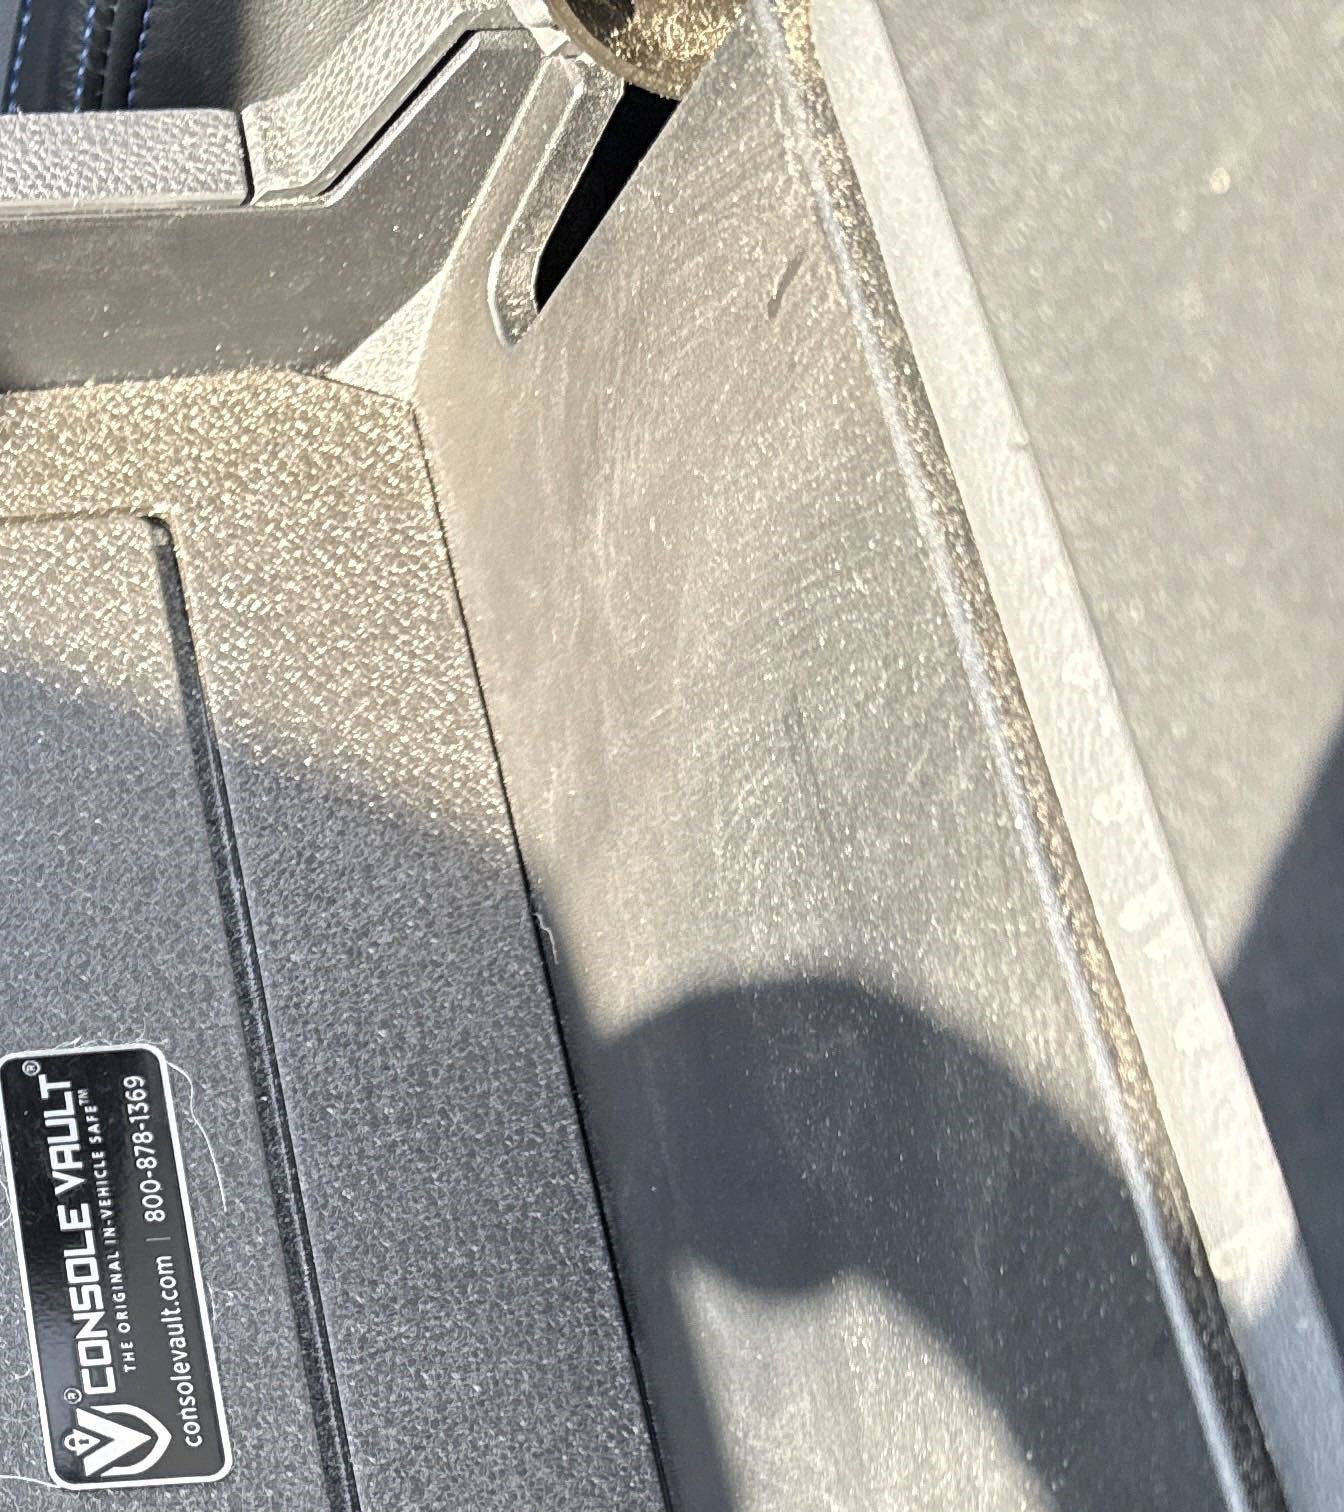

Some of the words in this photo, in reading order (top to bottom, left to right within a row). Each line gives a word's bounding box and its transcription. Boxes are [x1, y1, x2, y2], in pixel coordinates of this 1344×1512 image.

[91, 1151, 117, 1246] IN-VEHICLE
[123, 1075, 165, 1222] 800-878-1369
[57, 1203, 116, 1395] CONSOLE
[108, 1250, 131, 1334] ORIGINAL
[154, 1255, 203, 1448] consolevault.com
[121, 1340, 137, 1373] THE
